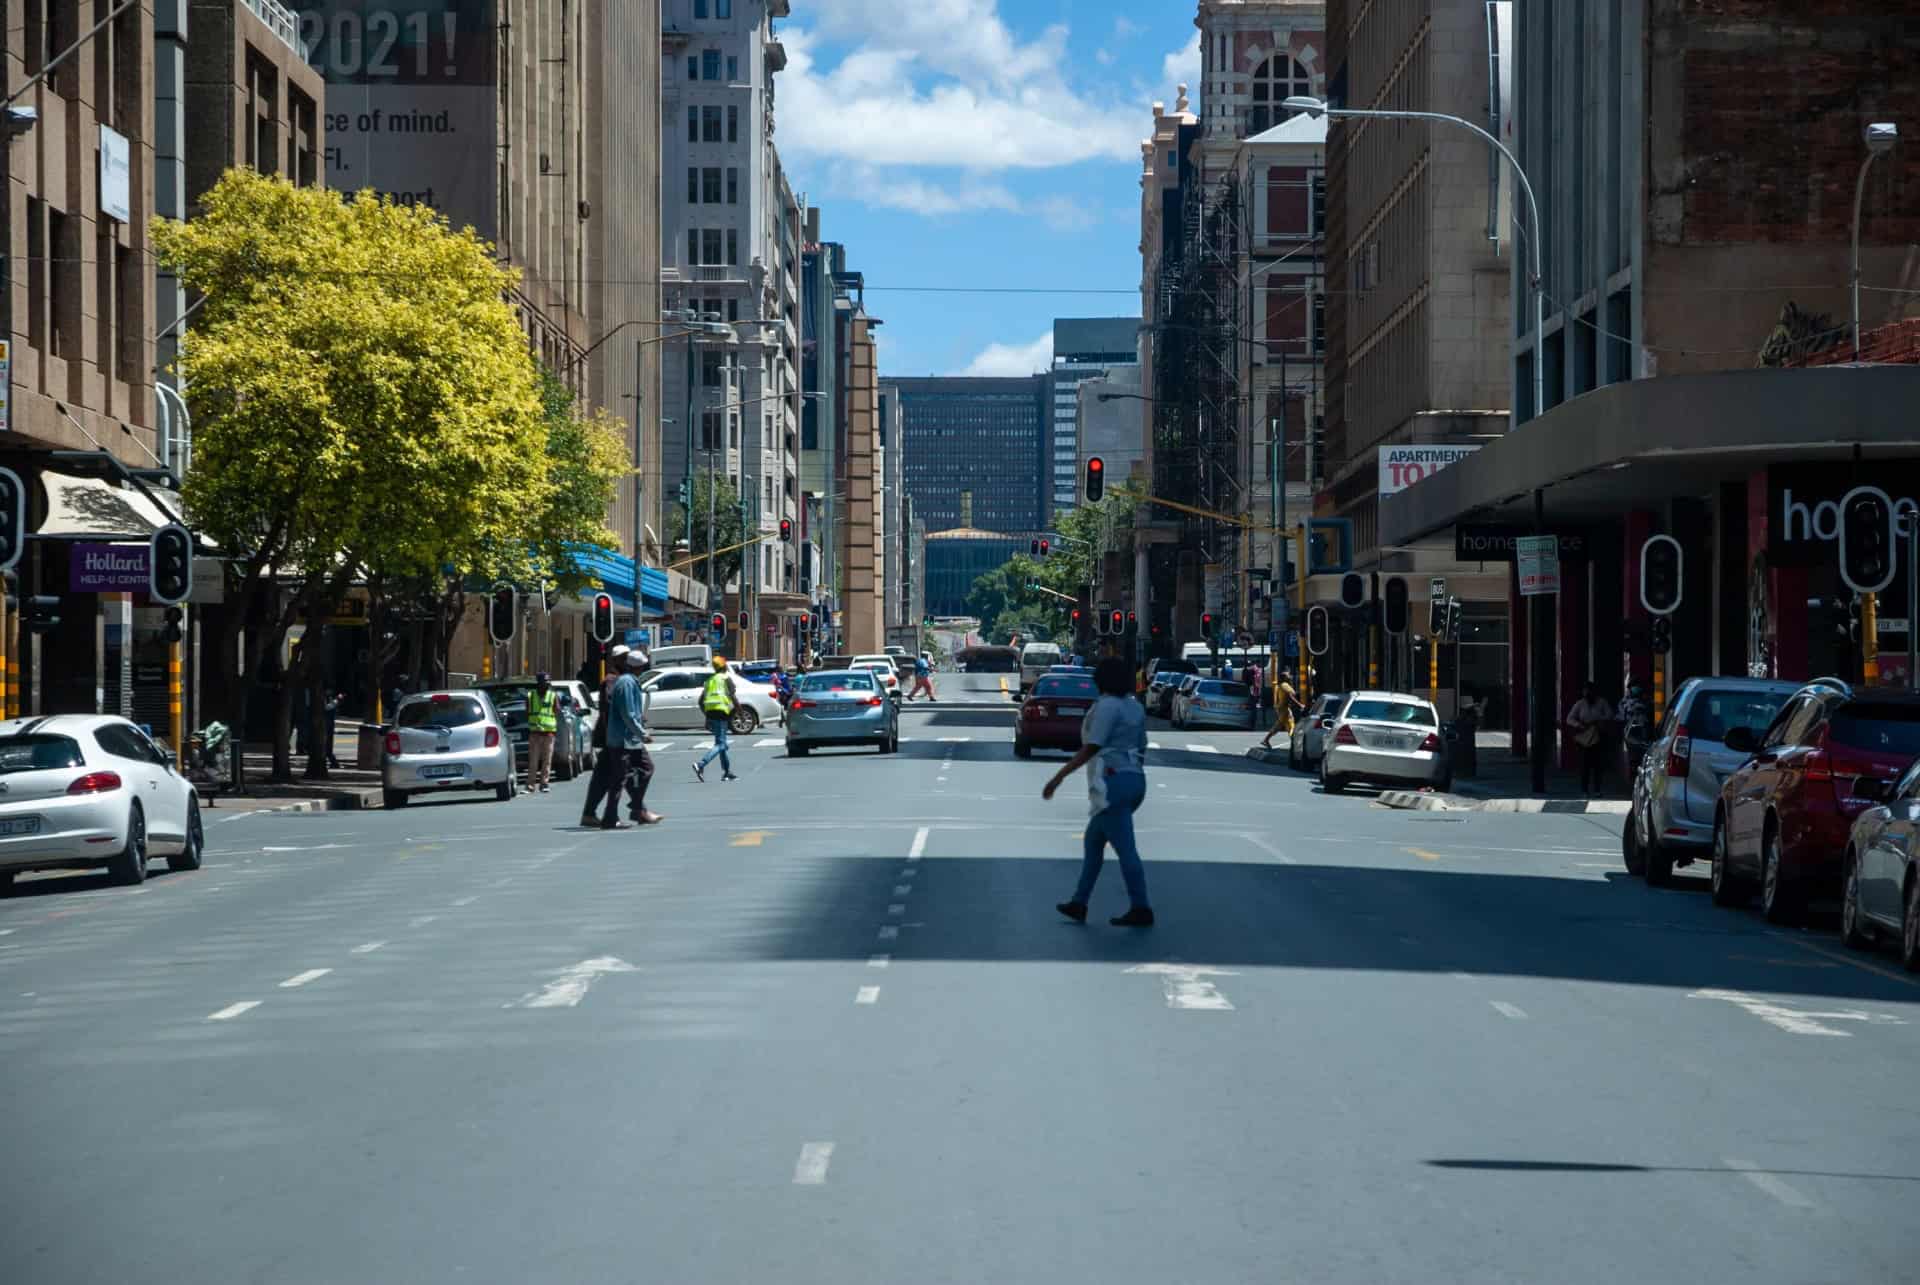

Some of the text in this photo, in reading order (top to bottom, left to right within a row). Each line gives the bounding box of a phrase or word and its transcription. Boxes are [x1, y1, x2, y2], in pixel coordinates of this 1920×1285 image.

[357, 109, 381, 132] of
[388, 110, 455, 132] mind.
[1389, 463, 1425, 488] TO
[1782, 488, 1918, 541] hoe
[85, 552, 145, 571] Hollard
[80, 575, 150, 585] HELP-U CENTR
